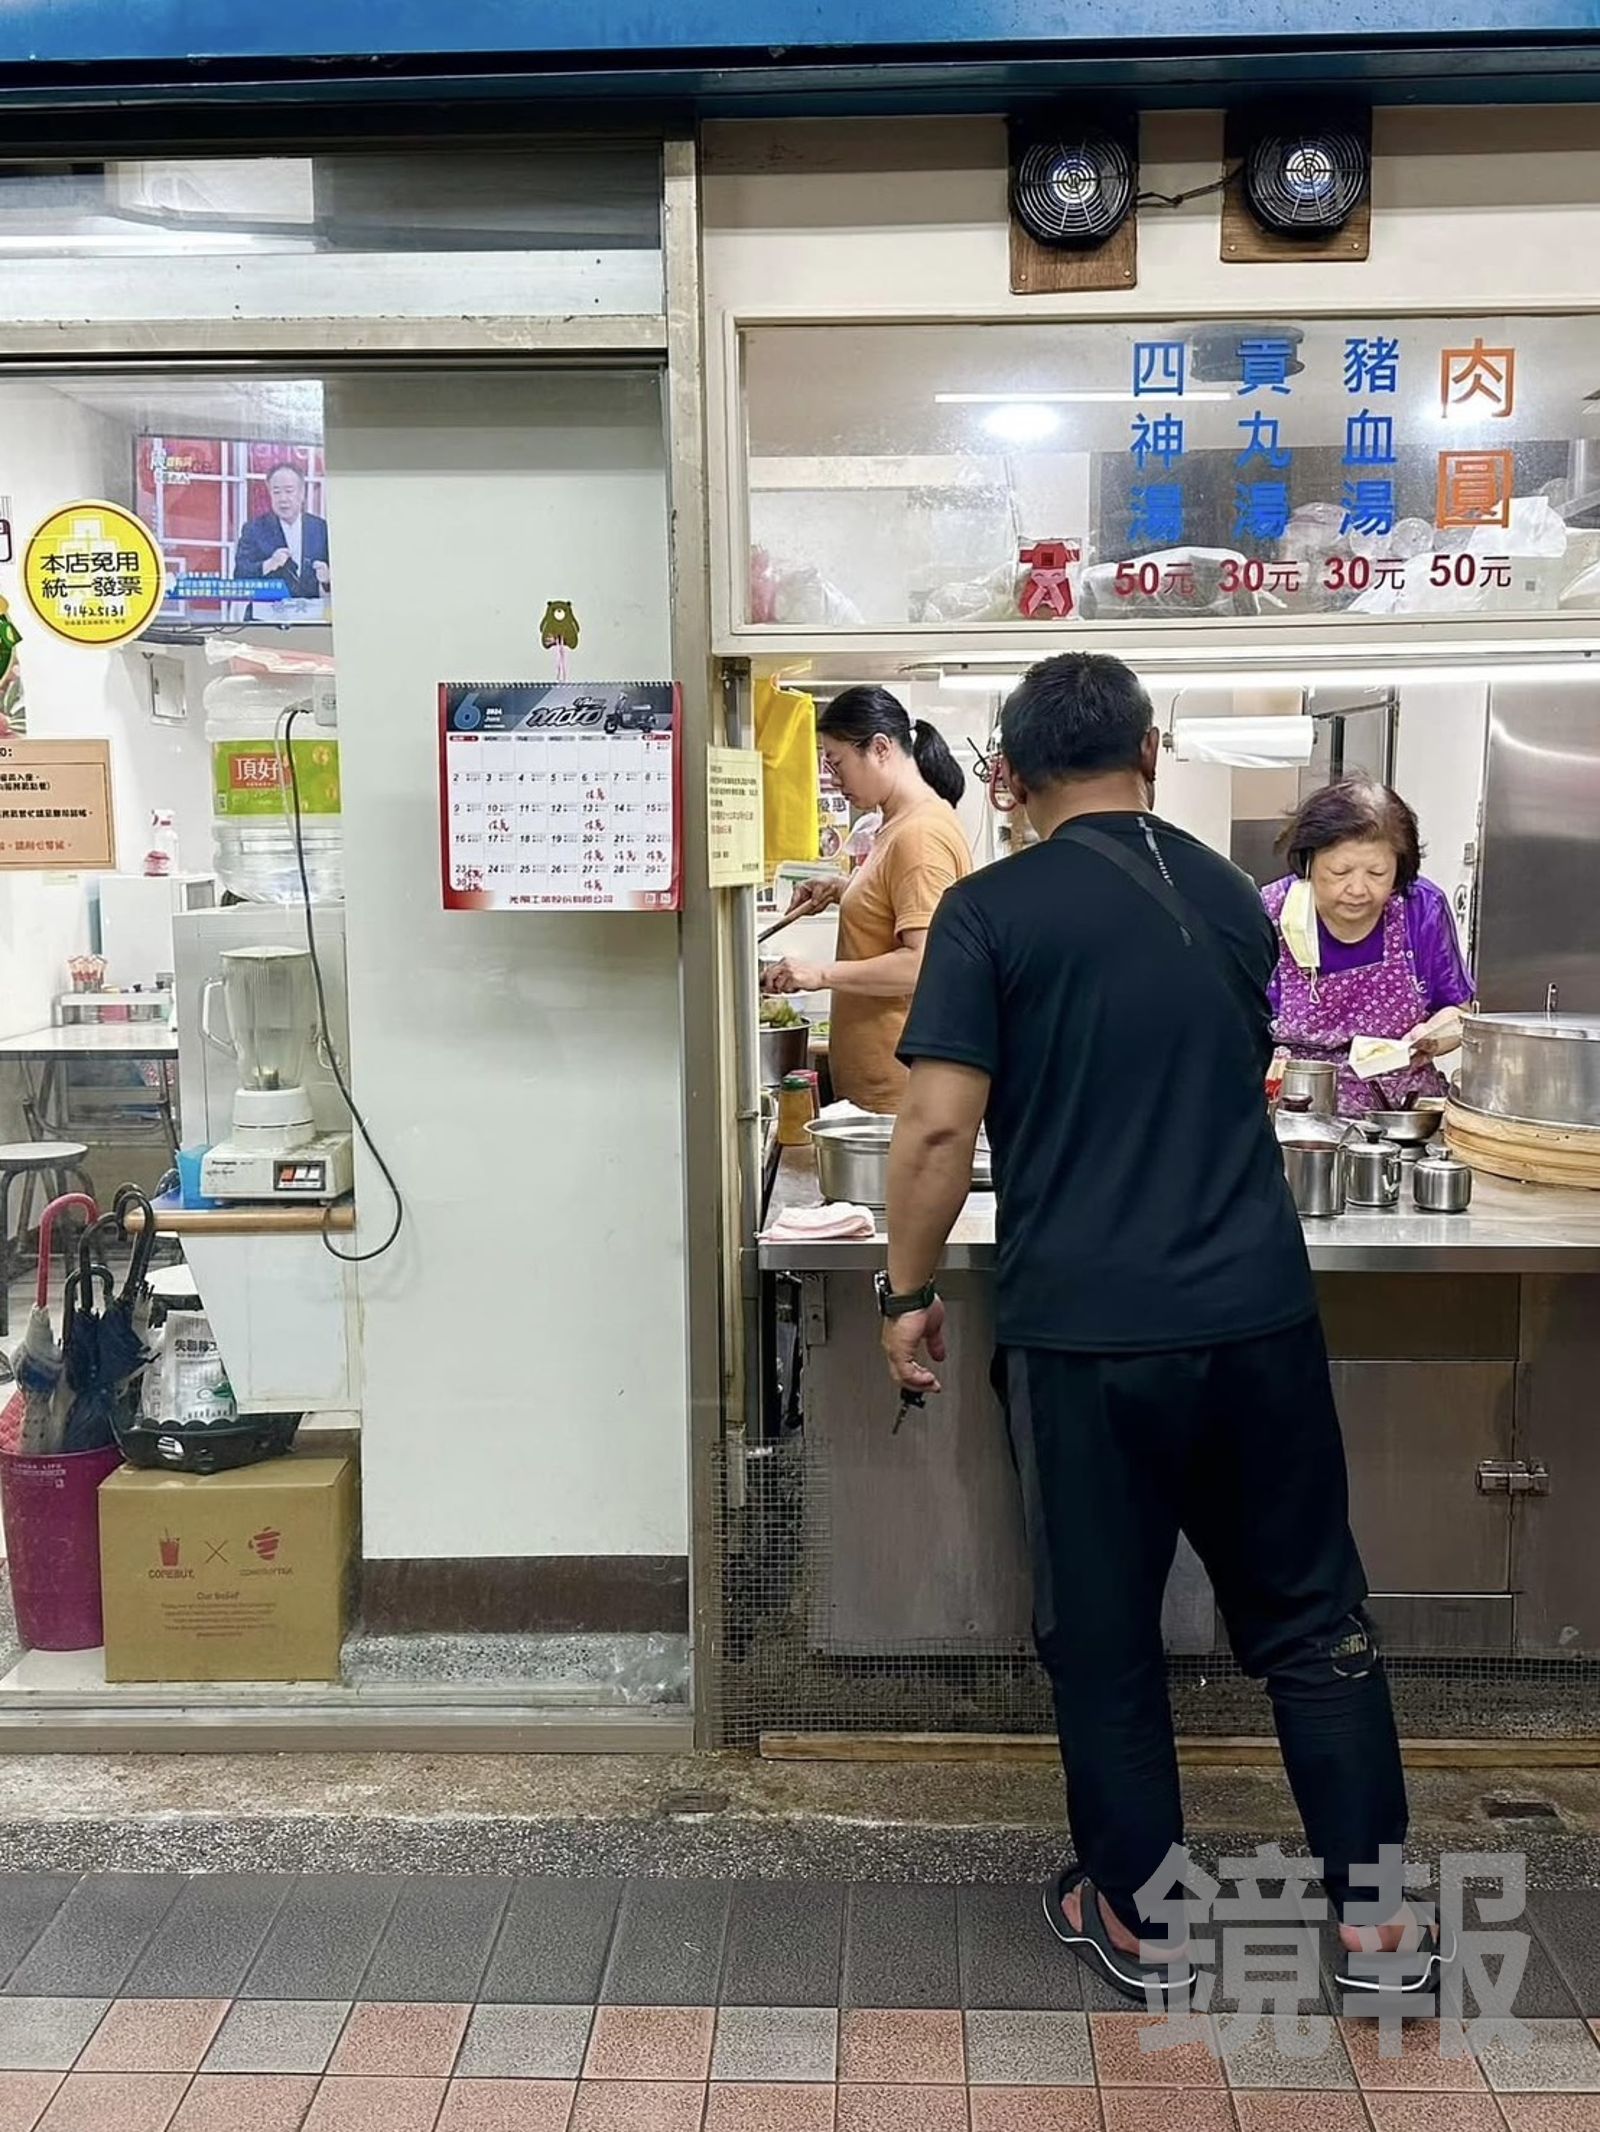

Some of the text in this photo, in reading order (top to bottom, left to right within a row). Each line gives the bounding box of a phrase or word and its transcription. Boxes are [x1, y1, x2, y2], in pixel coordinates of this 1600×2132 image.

[1126, 339, 1185, 544] 四神湯
[1232, 338, 1292, 541] 貢丸湯
[1340, 336, 1399, 537] 豬血湯
[1435, 338, 1516, 531] 肉圓
[40, 551, 140, 574] 本店免用
[1114, 561, 1195, 596] 50元
[1218, 559, 1300, 594] 30元
[1323, 556, 1405, 592] 30元
[1429, 553, 1512, 588] 50元
[41, 575, 143, 599] 統一發票
[64, 604, 124, 618] 91425131
[454, 693, 481, 730] 6
[234, 757, 281, 781] 頂好
